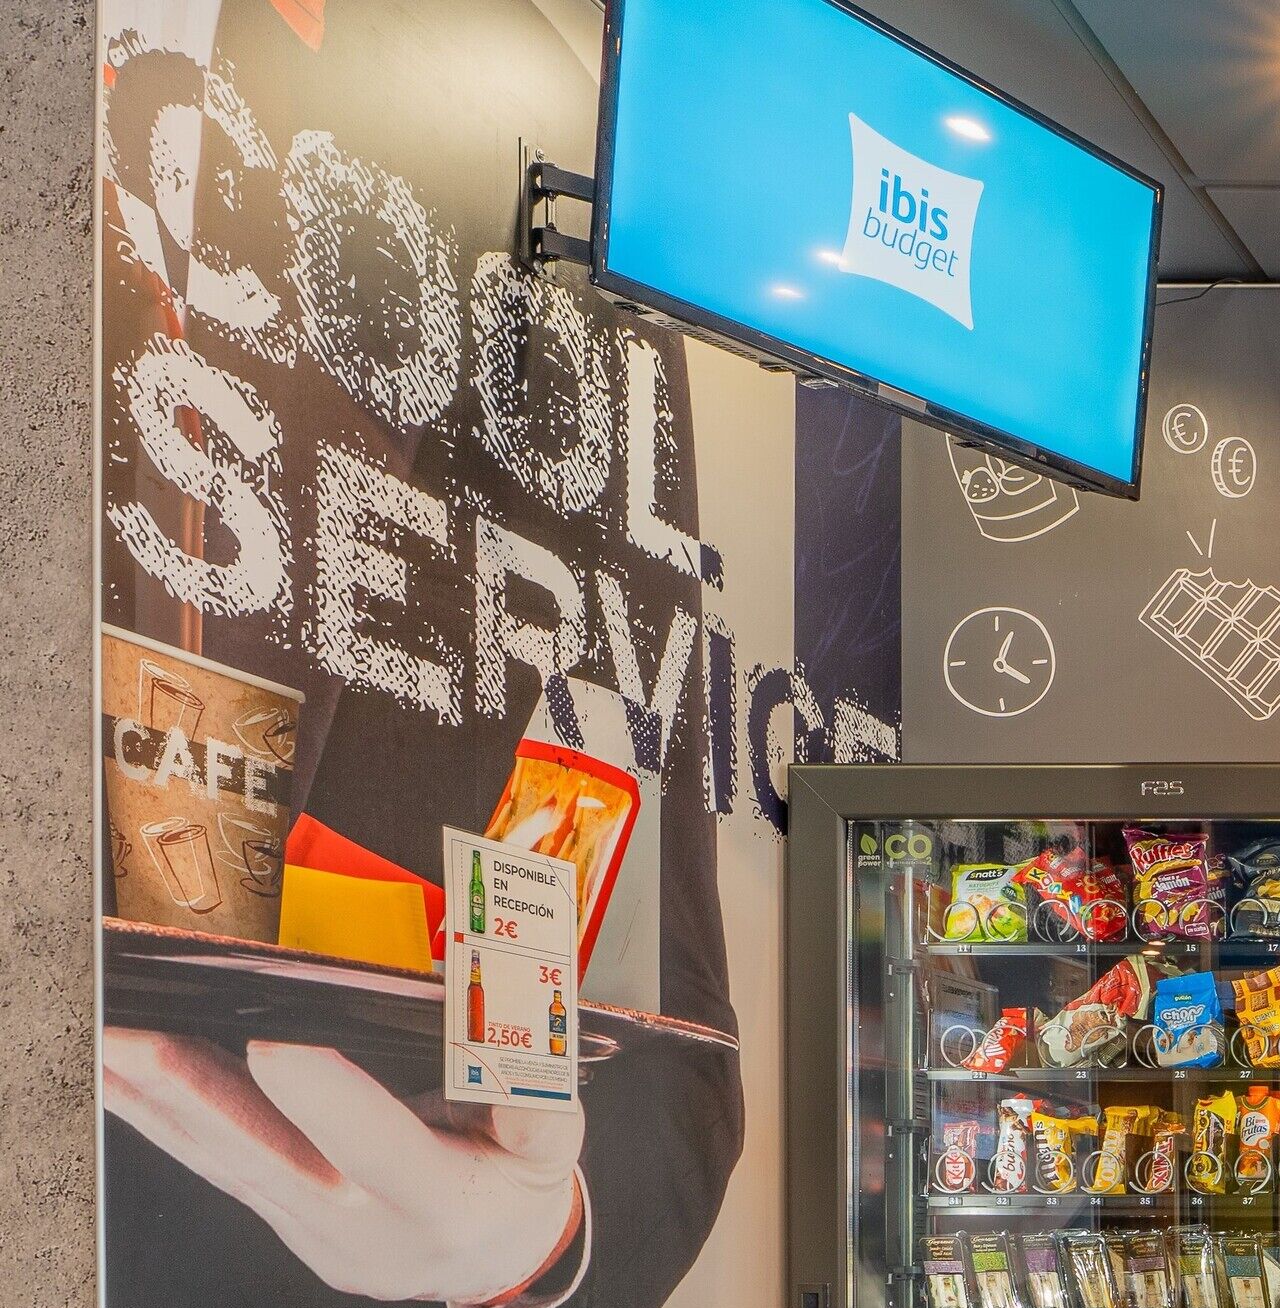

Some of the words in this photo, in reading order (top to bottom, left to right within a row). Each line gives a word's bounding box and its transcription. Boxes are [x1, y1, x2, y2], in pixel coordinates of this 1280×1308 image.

[879, 167, 948, 241] ibis
[863, 206, 958, 277] budget
[102, 26, 724, 592] COOL
[112, 716, 278, 818] CAFE
[1130, 842, 1193, 874] Ruffles
[858, 860, 882, 868] power
[493, 860, 557, 887] DISPONIBLE
[969, 868, 1006, 879] snatt's
[493, 877, 508, 892] EN
[493, 895, 554, 919] RECEPCIÓN
[494, 917, 519, 939] 2€
[1076, 944, 1086, 952] 13
[1186, 944, 1196, 952] 15
[1267, 943, 1279, 952] 17
[538, 965, 563, 986] 3€
[487, 1027, 533, 1049] 2,50€
[972, 1071, 984, 1079] 21
[1075, 1071, 1087, 1079] 23
[1174, 1071, 1185, 1079] 25
[1240, 1071, 1250, 1079] 27
[1245, 1116, 1255, 1127] Bi
[1242, 1125, 1268, 1138] frutas
[1151, 1136, 1174, 1189] TWIX
[949, 1197, 959, 1205] 31
[996, 1197, 1007, 1205] 32
[1046, 1197, 1057, 1205] 33
[1090, 1197, 1101, 1205] 34
[1139, 1197, 1150, 1205] 35
[1191, 1197, 1203, 1205] 36
[1242, 1197, 1253, 1205] 37
